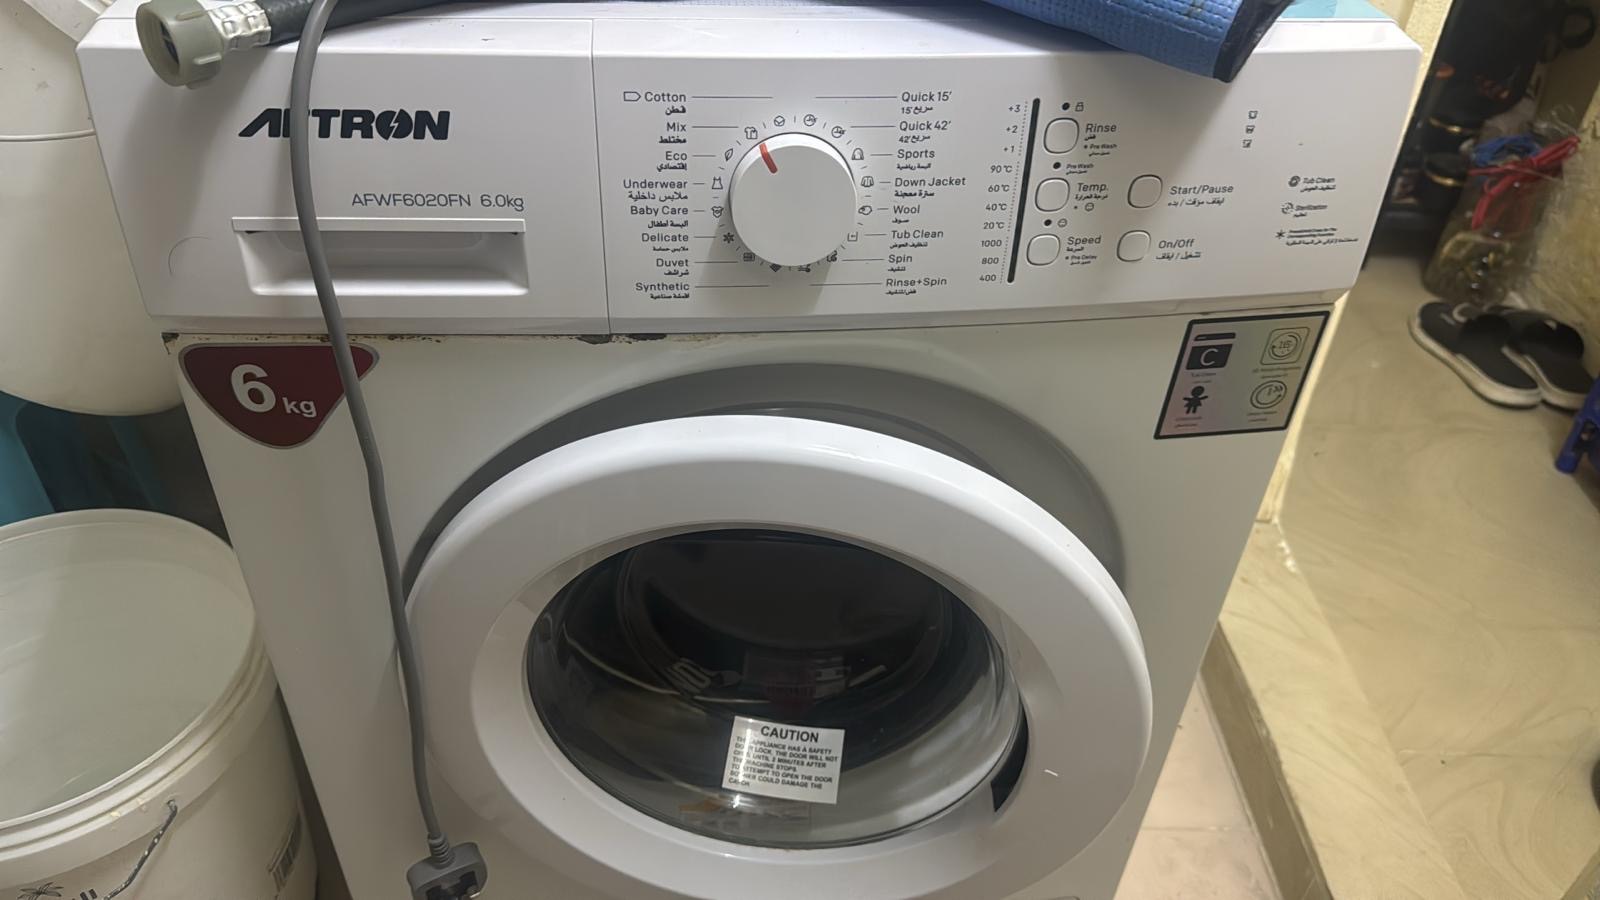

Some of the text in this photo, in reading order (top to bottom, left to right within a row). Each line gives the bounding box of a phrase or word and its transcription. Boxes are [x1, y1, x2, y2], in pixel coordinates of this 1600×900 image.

[644, 91, 686, 102] Cotton
[901, 91, 935, 102] Quick
[665, 105, 686, 115] قطن
[1008, 104, 1021, 113] +3
[666, 122, 687, 132] Mix
[899, 120, 932, 131] Quick
[1006, 125, 1018, 134] +2
[1085, 123, 1117, 133] Rinse
[658, 135, 687, 143] مختلط
[897, 148, 935, 160] Sports
[1003, 145, 1015, 153] +1
[665, 151, 688, 161] Eco
[623, 178, 688, 189] Underwear
[894, 176, 966, 187] Down Jacket
[1077, 182, 1109, 193] Temp.
[1170, 184, 1234, 195] Start/Pause
[628, 191, 688, 202] ملابس داخلية
[351, 193, 525, 212] AFWF6020FN 6.0kg
[630, 205, 689, 217] Baby Care
[893, 204, 920, 214] Wool
[641, 233, 689, 242] Delicate
[891, 229, 944, 239] Tub Clean
[981, 239, 1002, 247] 1000
[1067, 235, 1101, 246] Speed
[1158, 239, 1195, 249] On/Off
[656, 258, 689, 267] Duvet
[888, 254, 913, 264] Spin
[981, 257, 999, 265] 800
[664, 269, 690, 277] شراشف
[979, 274, 997, 282] 400
[635, 282, 690, 292] Synthetic
[886, 277, 948, 287] Rinse+Spin
[1200, 348, 1219, 366] C
[231, 364, 317, 418] 6 kg
[761, 725, 819, 743] CAUTION
[789, 752, 807, 760] DOOR
[808, 747, 832, 755] SAFETY
[777, 757, 805, 767] MINUTES
[758, 775, 780, 784] COULD
[781, 779, 808, 788] DAMAGE
